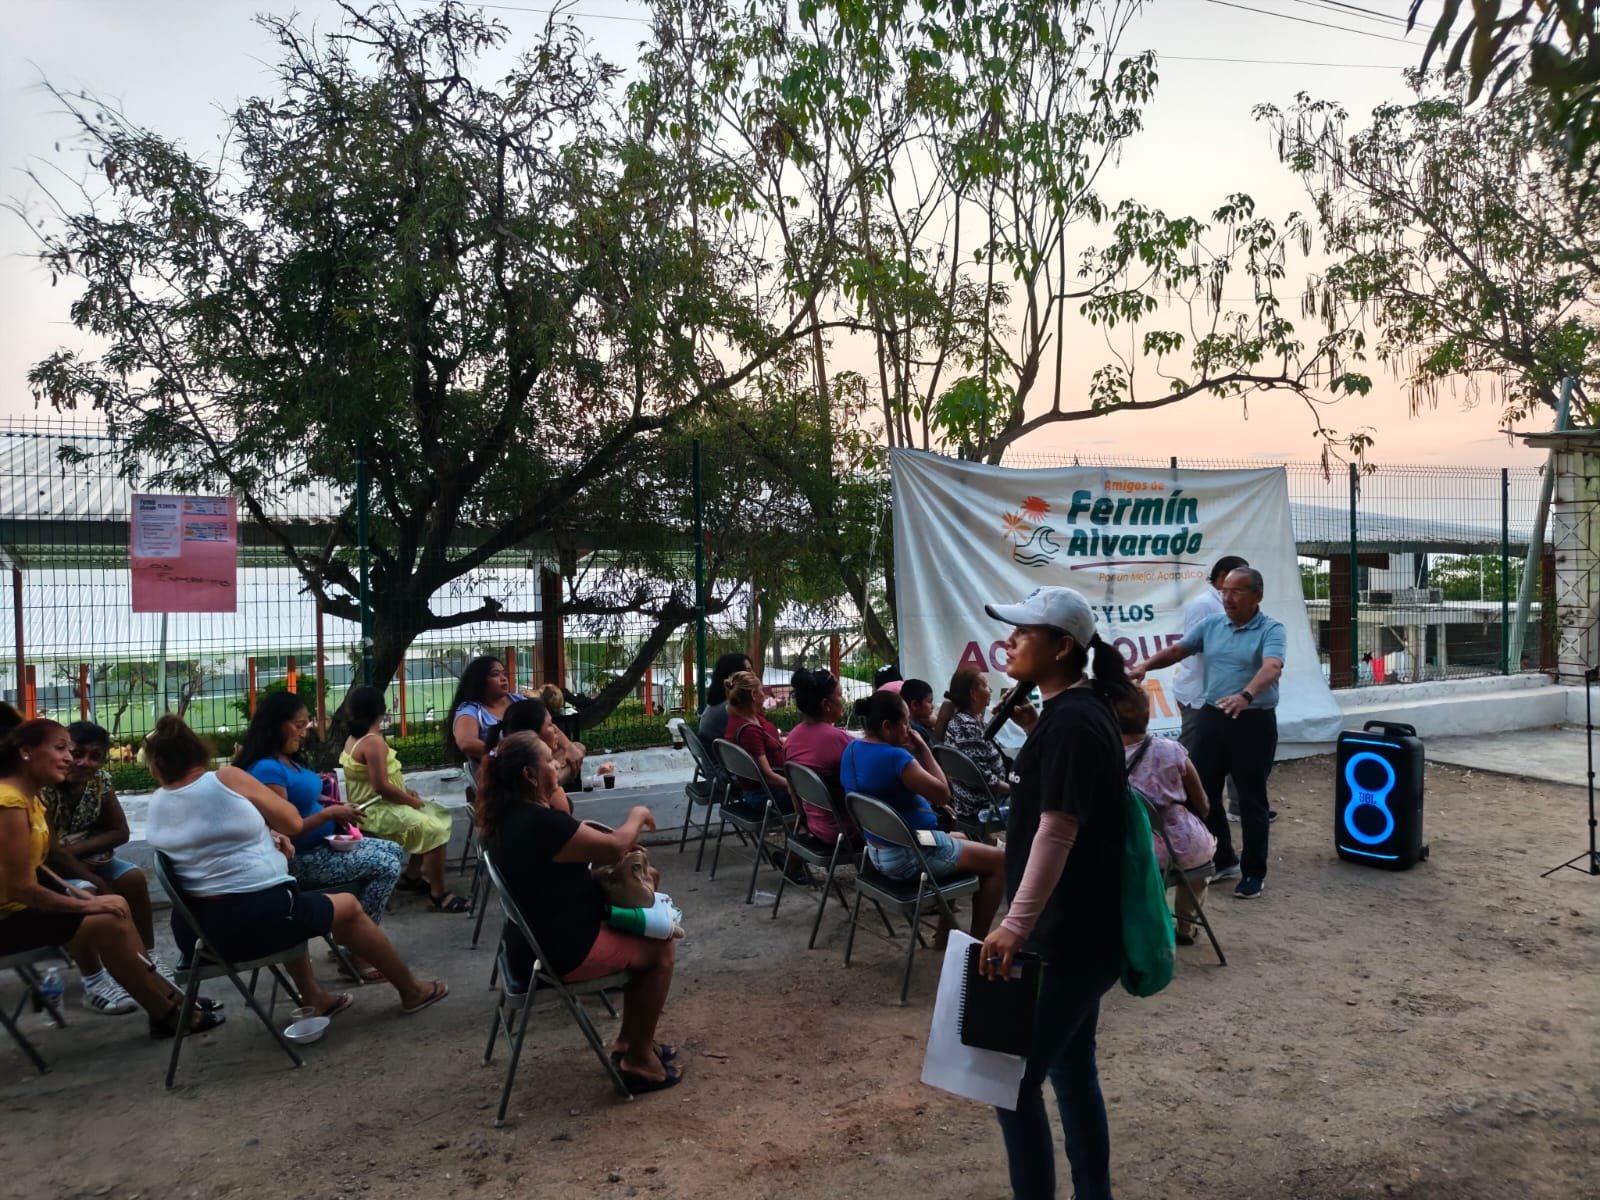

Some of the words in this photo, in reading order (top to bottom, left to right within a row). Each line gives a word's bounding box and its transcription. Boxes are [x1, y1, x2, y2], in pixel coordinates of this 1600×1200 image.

[1104, 480, 1148, 493] Amigos
[1066, 489, 1199, 526] Fermín
[1066, 526, 1204, 557] Alvarado
[1101, 605, 1114, 624] Y
[1118, 604, 1155, 623] LOS
